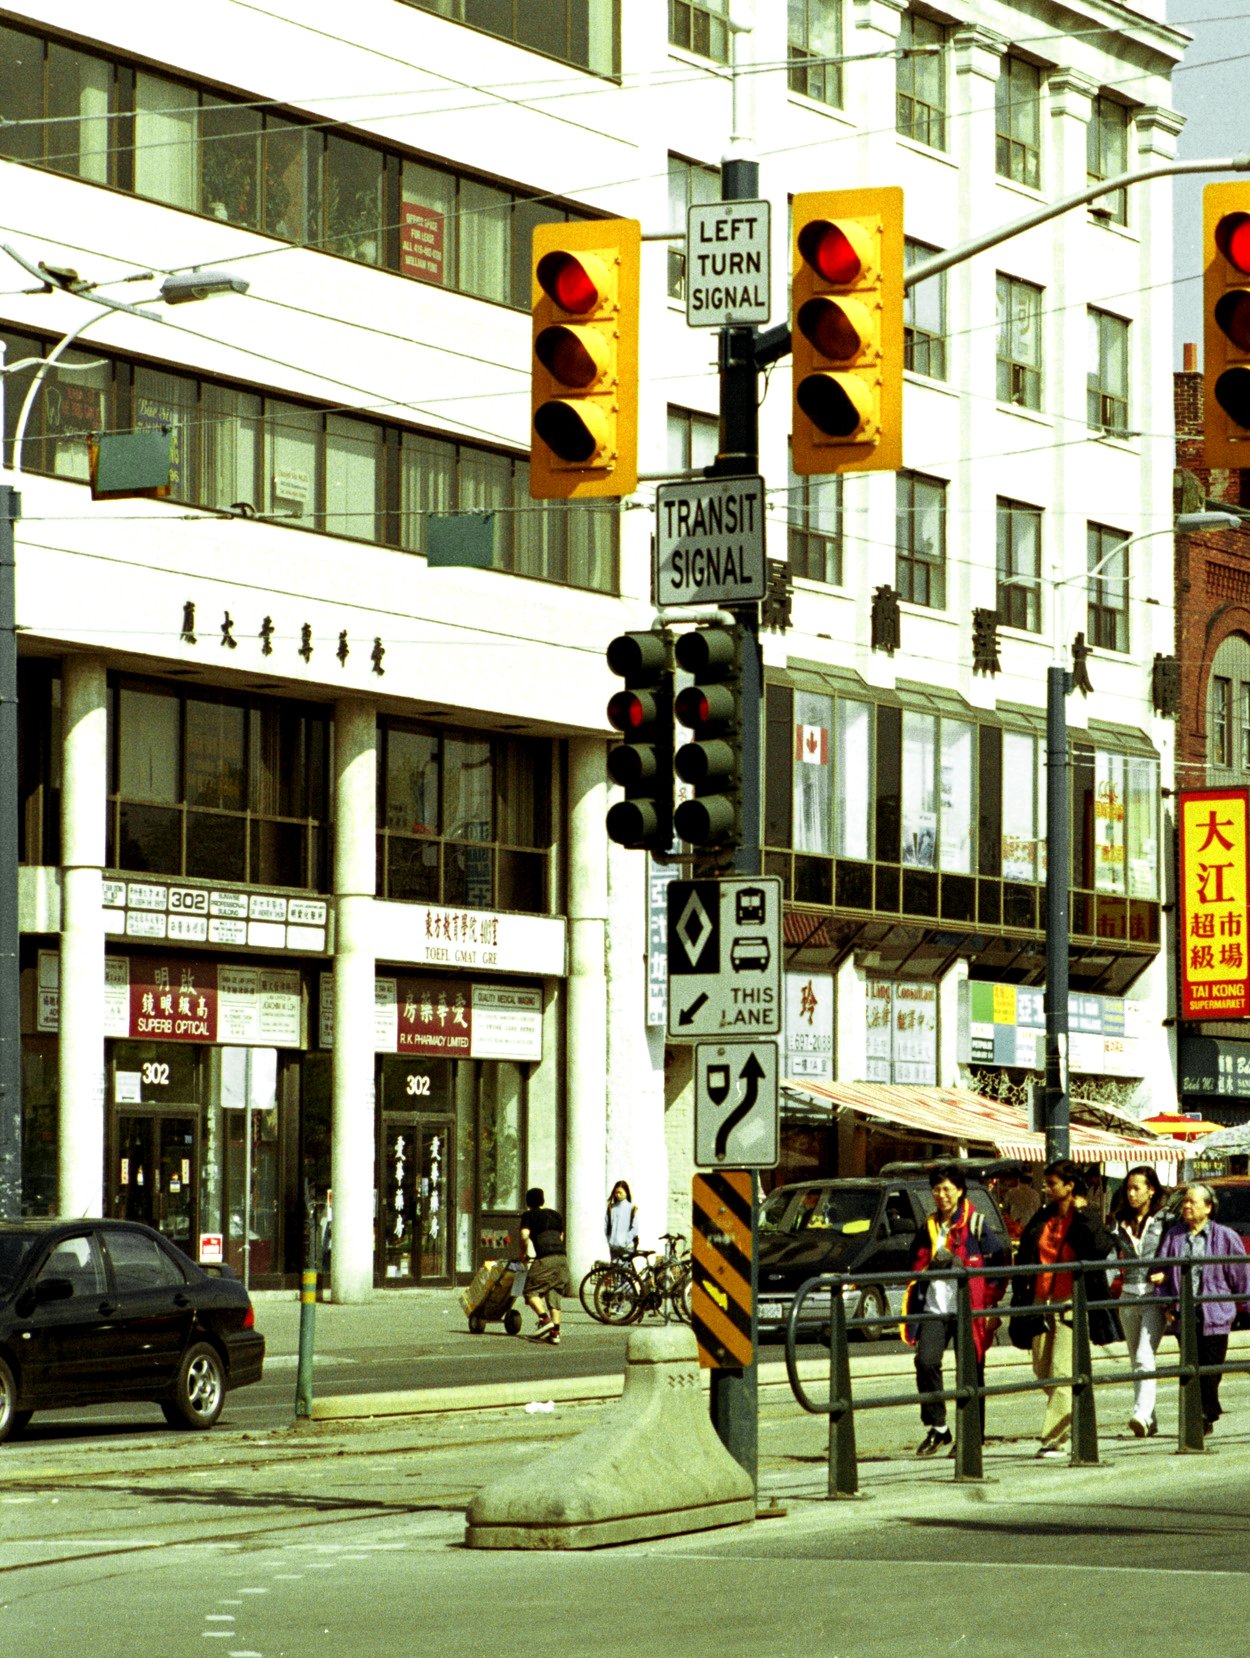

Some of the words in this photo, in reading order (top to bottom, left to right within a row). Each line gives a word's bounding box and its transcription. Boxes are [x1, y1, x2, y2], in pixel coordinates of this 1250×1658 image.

[700, 218, 757, 242] LEFT
[697, 251, 761, 276] TURN
[692, 285, 765, 310] SIGNAL
[664, 493, 757, 538] TRANSIT
[671, 545, 752, 589] SIGNAL
[1195, 811, 1235, 905] 大江
[171, 891, 206, 911] 302
[425, 946, 450, 961] TOEFL
[455, 949, 477, 963] GMAT
[482, 951, 498, 964] GRE
[731, 988, 773, 1004] THIS
[1191, 985, 1209, 998] TAI
[1212, 984, 1245, 996] KONG
[1190, 998, 1245, 1010] SUPERMARKET
[137, 1018, 172, 1035] SUPERB
[175, 1019, 209, 1036] OPTICAL
[720, 1009, 773, 1027] LANE
[415, 1034, 446, 1047] PHARMACY
[447, 1036, 469, 1048] LIMITED
[142, 1062, 170, 1085] 302
[406, 1074, 431, 1096] 302
